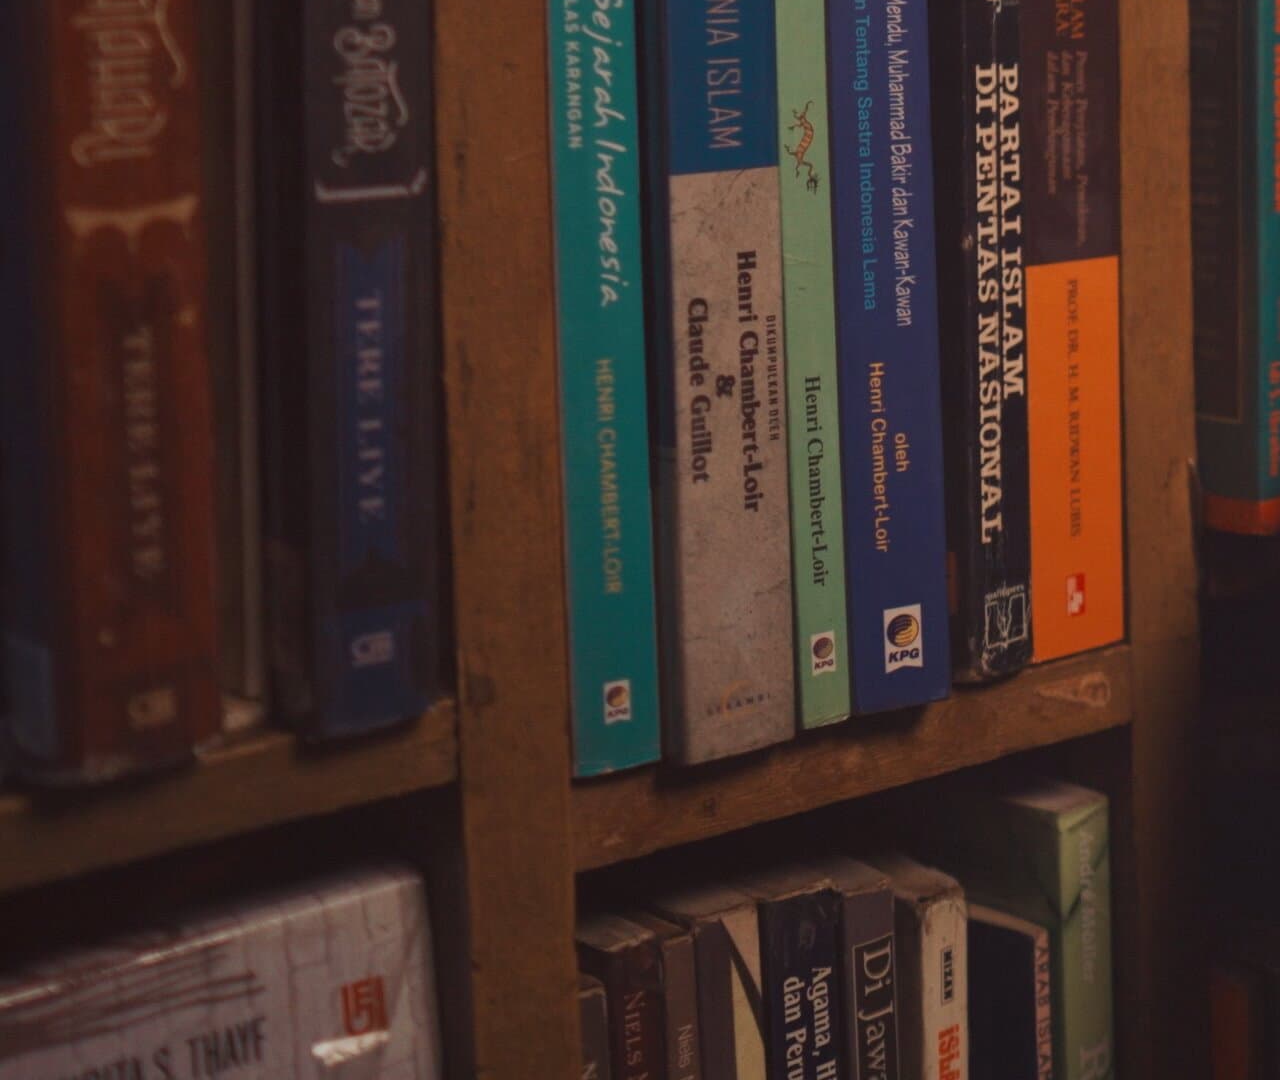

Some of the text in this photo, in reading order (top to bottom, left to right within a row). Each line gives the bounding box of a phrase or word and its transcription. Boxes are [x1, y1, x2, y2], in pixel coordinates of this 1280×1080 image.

[564, 41, 584, 150] KARANGAN
[852, 15, 872, 92] Tentang
[887, 49, 912, 141] Muhammad
[704, 57, 743, 150] ISLAM
[856, 96, 875, 157] Sastra
[859, 162, 878, 254] Indonesia
[889, 143, 913, 185] Bakir
[891, 187, 914, 217] dan
[594, 138, 630, 308] Indonesia
[999, 62, 1025, 400] PARTAI ISLAM
[862, 258, 879, 311] Lama
[892, 219, 917, 329] Kawan-Kawan
[975, 62, 1003, 545] DI PENTAS NASIONAL
[594, 358, 617, 422] HENRI
[685, 296, 714, 486] Claude Guillot
[715, 373, 737, 400] &
[736, 249, 765, 514] Henri Chambert-Loir
[803, 375, 830, 587] Henri Chambert-Loir
[868, 361, 891, 553] Henri Chambert-Loir
[894, 431, 911, 473] oleh
[1069, 488, 1083, 538] LUBIS
[888, 646, 921, 661] KPG
[783, 975, 806, 1024] dan
[806, 965, 833, 1057] Agama,
[863, 939, 893, 997] Di
